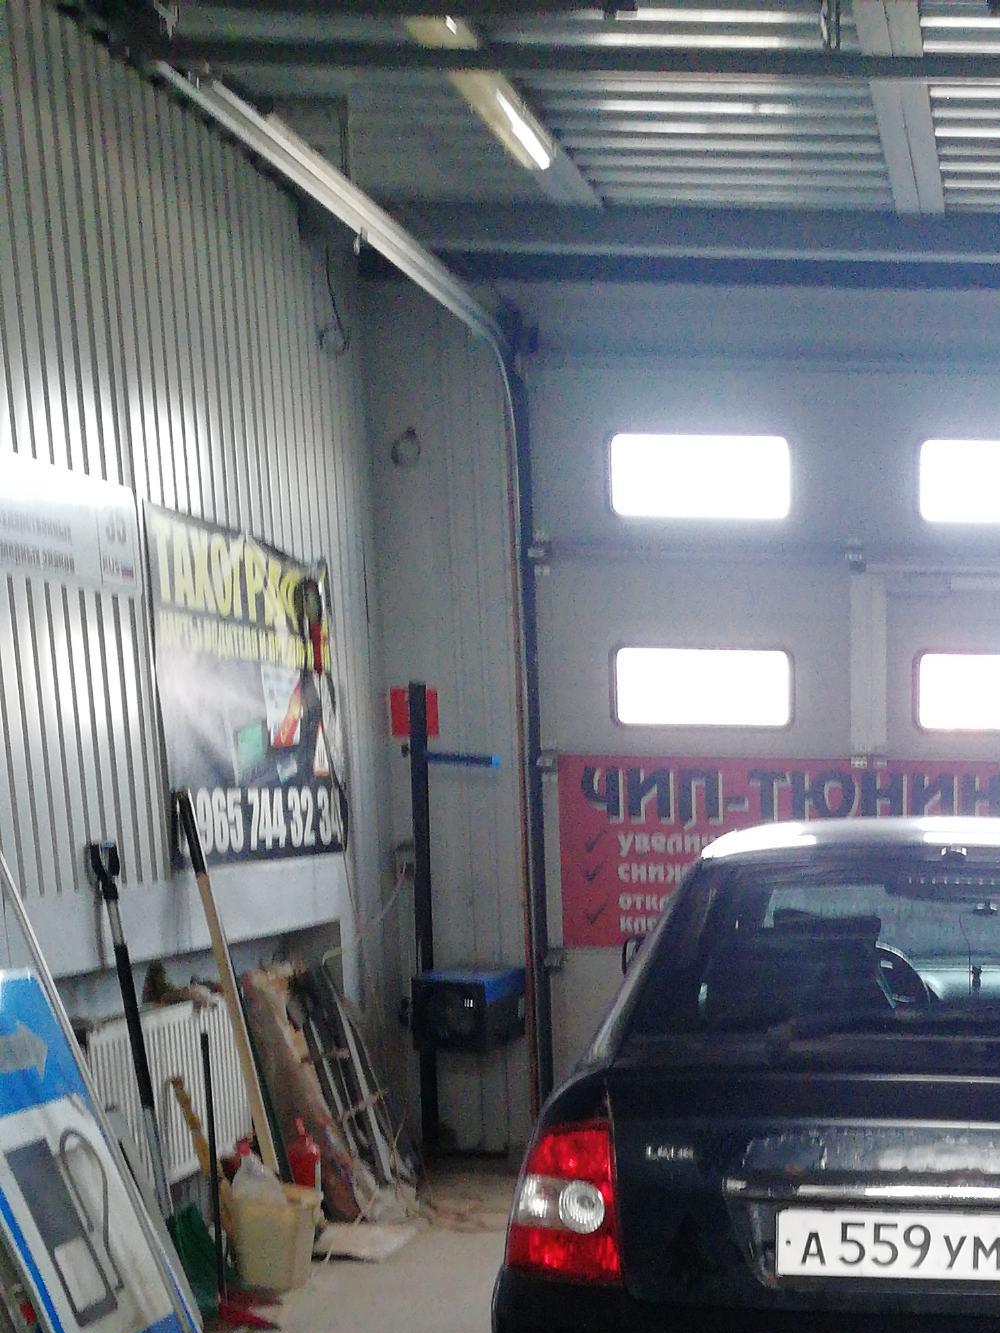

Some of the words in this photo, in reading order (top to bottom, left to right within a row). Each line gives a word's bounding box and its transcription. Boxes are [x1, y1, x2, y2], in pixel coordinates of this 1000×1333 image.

[176, 785, 245, 856] 965
[247, 785, 287, 851] 744
[288, 785, 316, 848] 32
